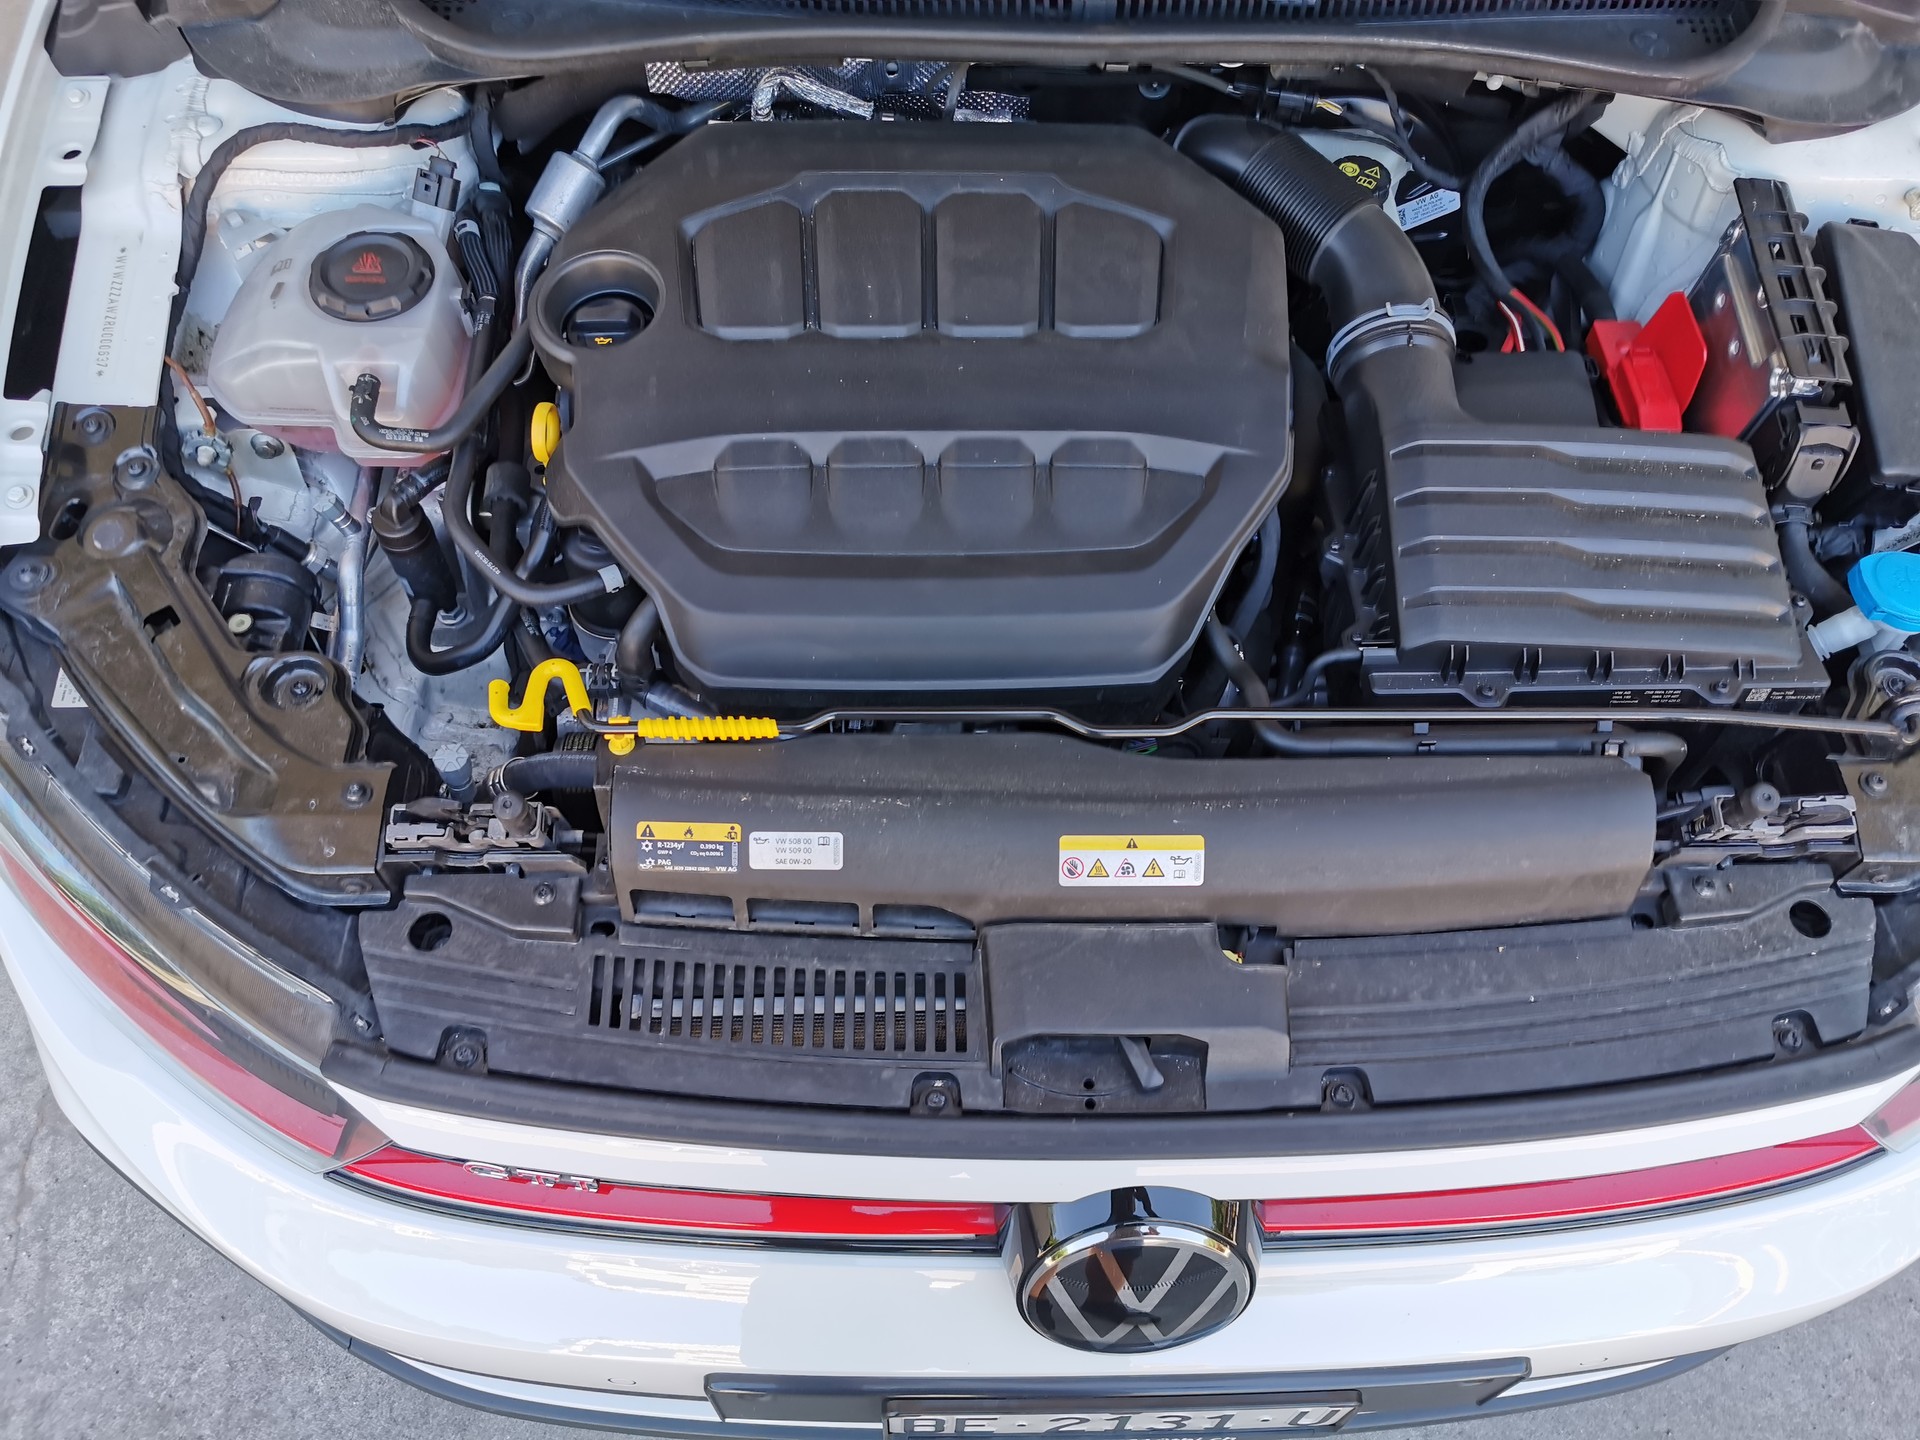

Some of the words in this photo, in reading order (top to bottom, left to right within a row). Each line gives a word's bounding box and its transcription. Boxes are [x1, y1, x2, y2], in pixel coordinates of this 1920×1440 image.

[657, 842, 685, 850] R-1234yf
[903, 1417, 998, 1433] BE
[1042, 1413, 1236, 1433] 2131
[1288, 1409, 1341, 1427] U
